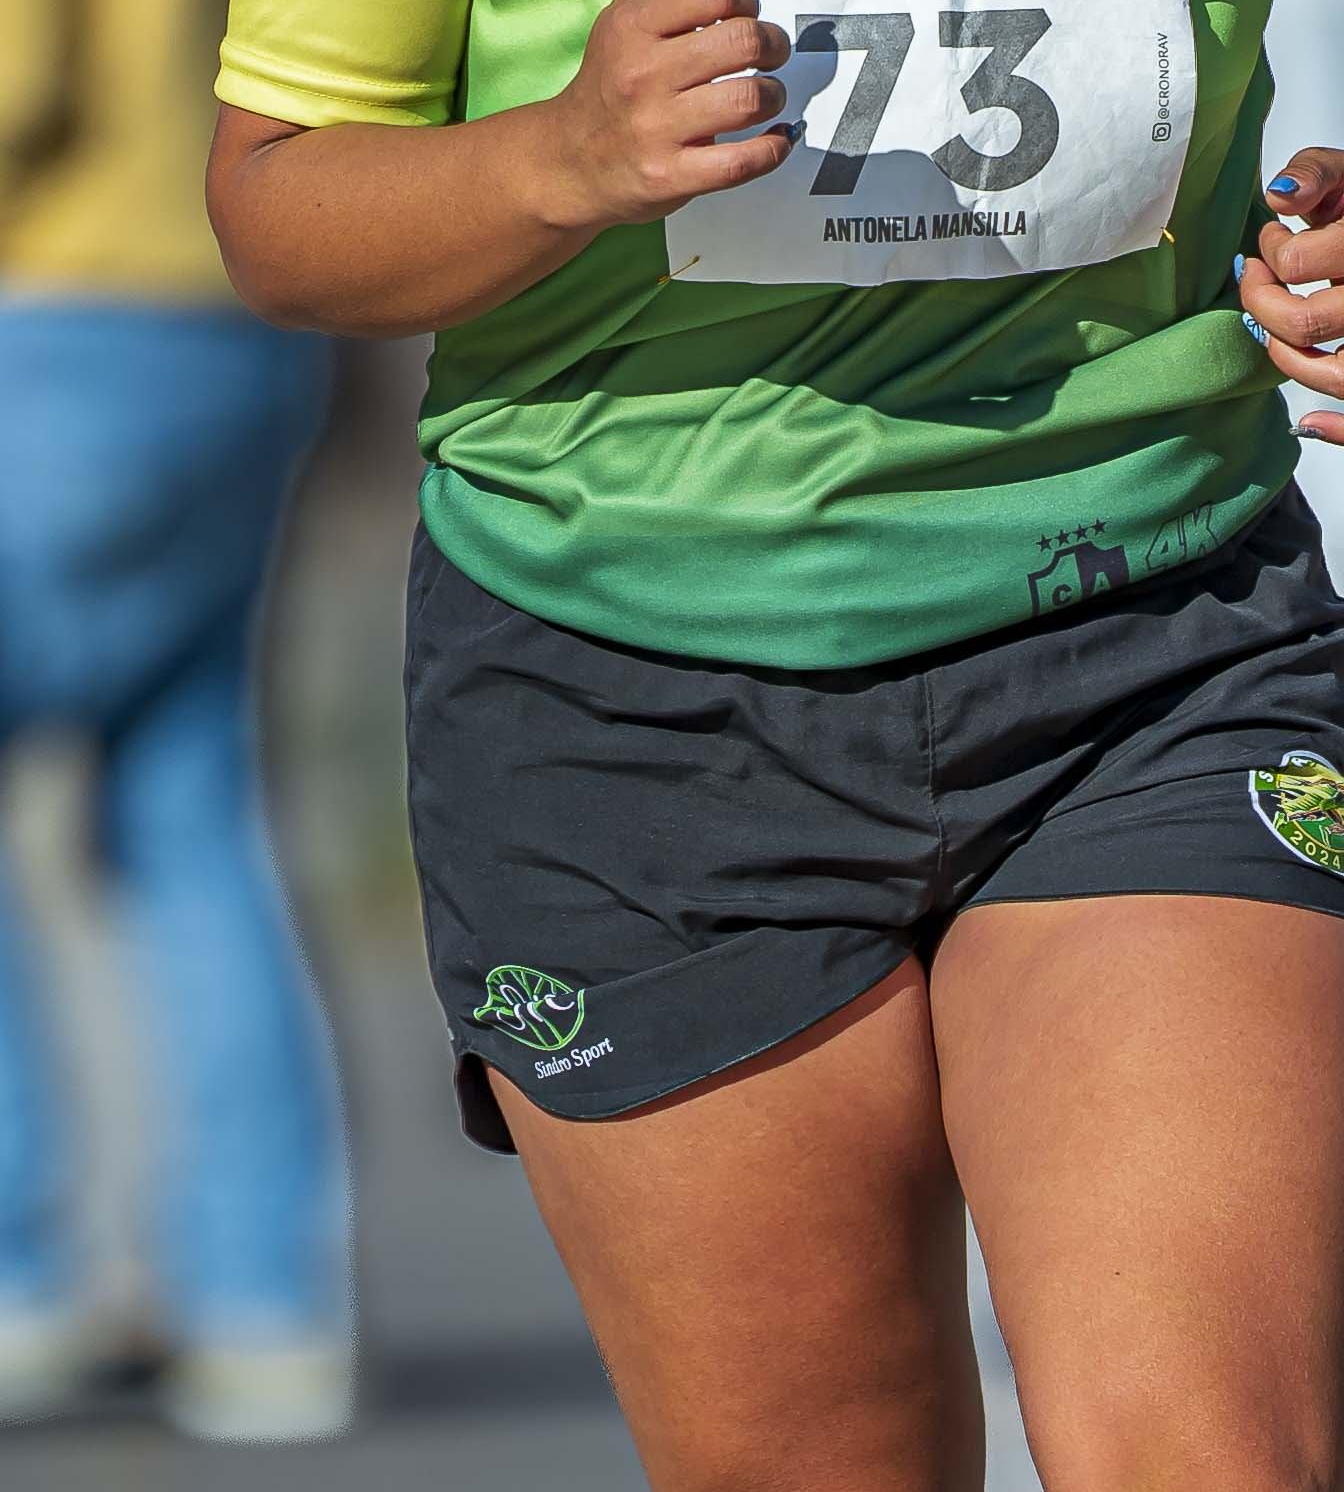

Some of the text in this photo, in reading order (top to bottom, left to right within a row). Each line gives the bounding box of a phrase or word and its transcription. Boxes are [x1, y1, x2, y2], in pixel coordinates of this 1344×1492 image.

[1158, 33, 1170, 120] @CRONORAV
[795, 8, 1059, 195] 73
[823, 210, 1027, 243] ANTONELA MANSILLA
[1289, 830, 1341, 870] 2024
[534, 1037, 614, 1079] Sindro Sport
